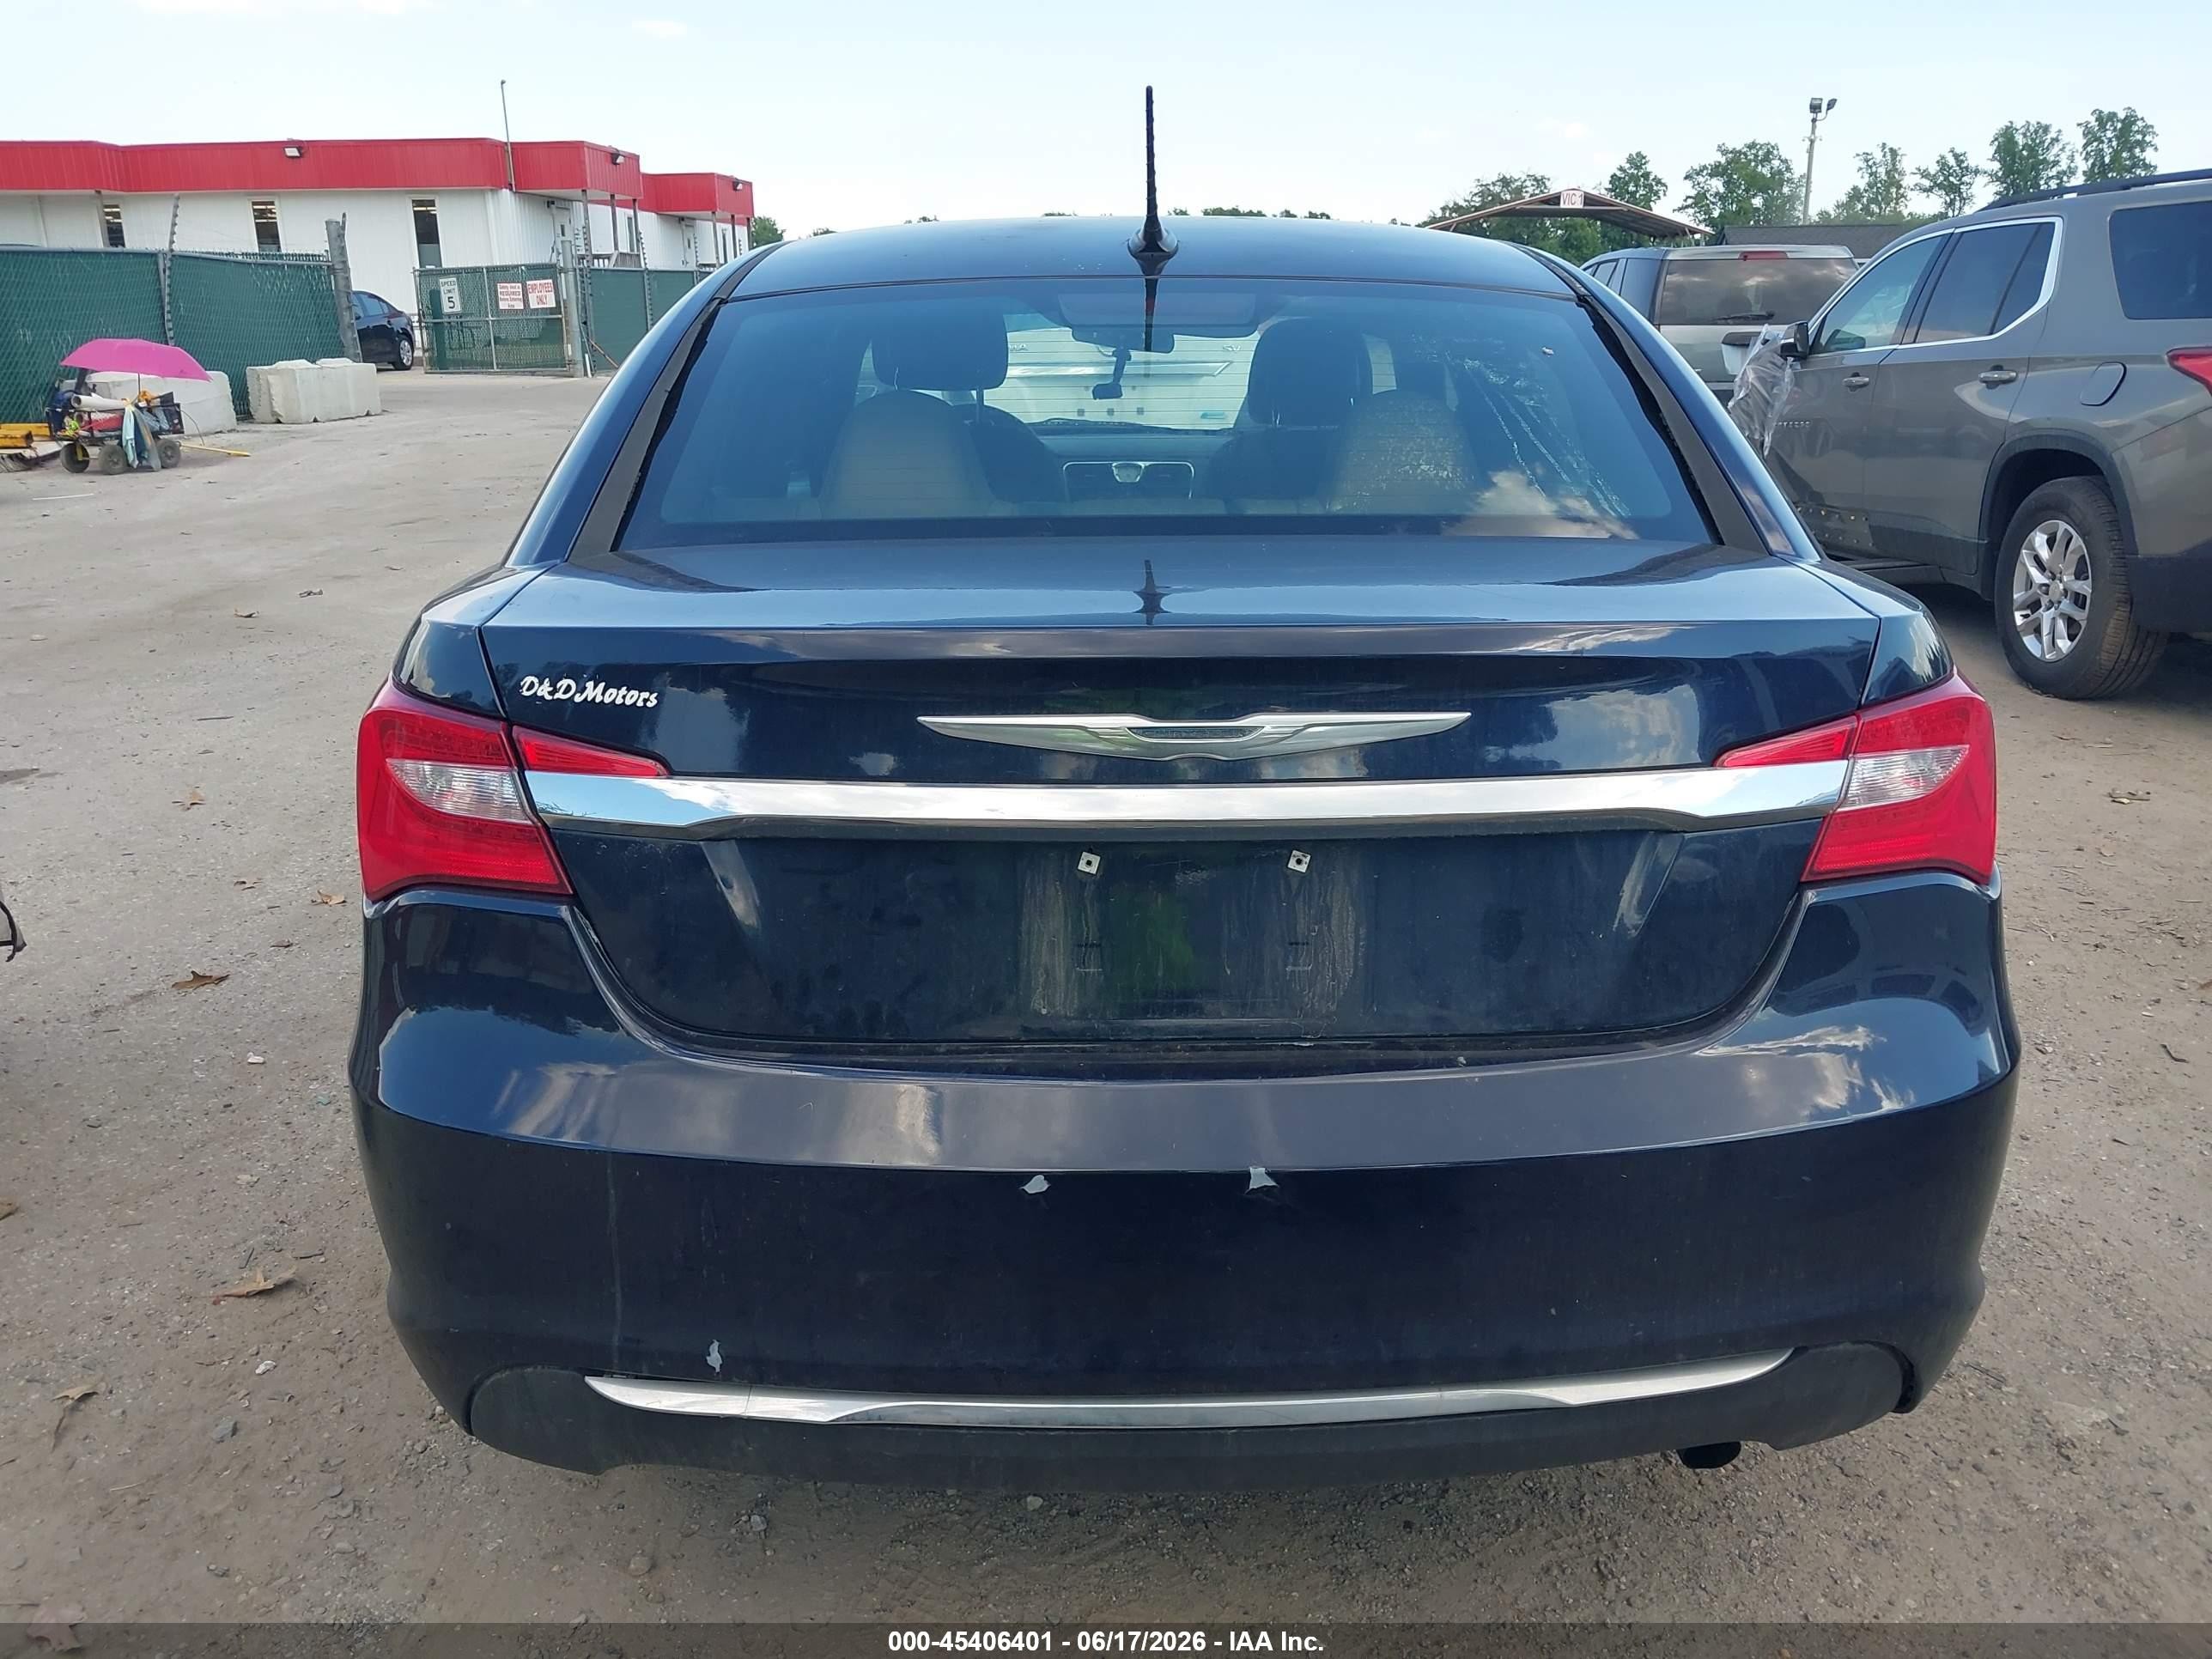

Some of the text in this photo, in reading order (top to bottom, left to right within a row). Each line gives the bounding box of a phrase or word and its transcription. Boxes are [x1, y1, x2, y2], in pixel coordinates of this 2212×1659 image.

[1562, 192, 1577, 205] VIC
[527, 282, 553, 294] EMPLOYEES
[447, 296, 455, 309] 5
[536, 295, 548, 306] ONLY
[574, 680, 659, 708] Motors
